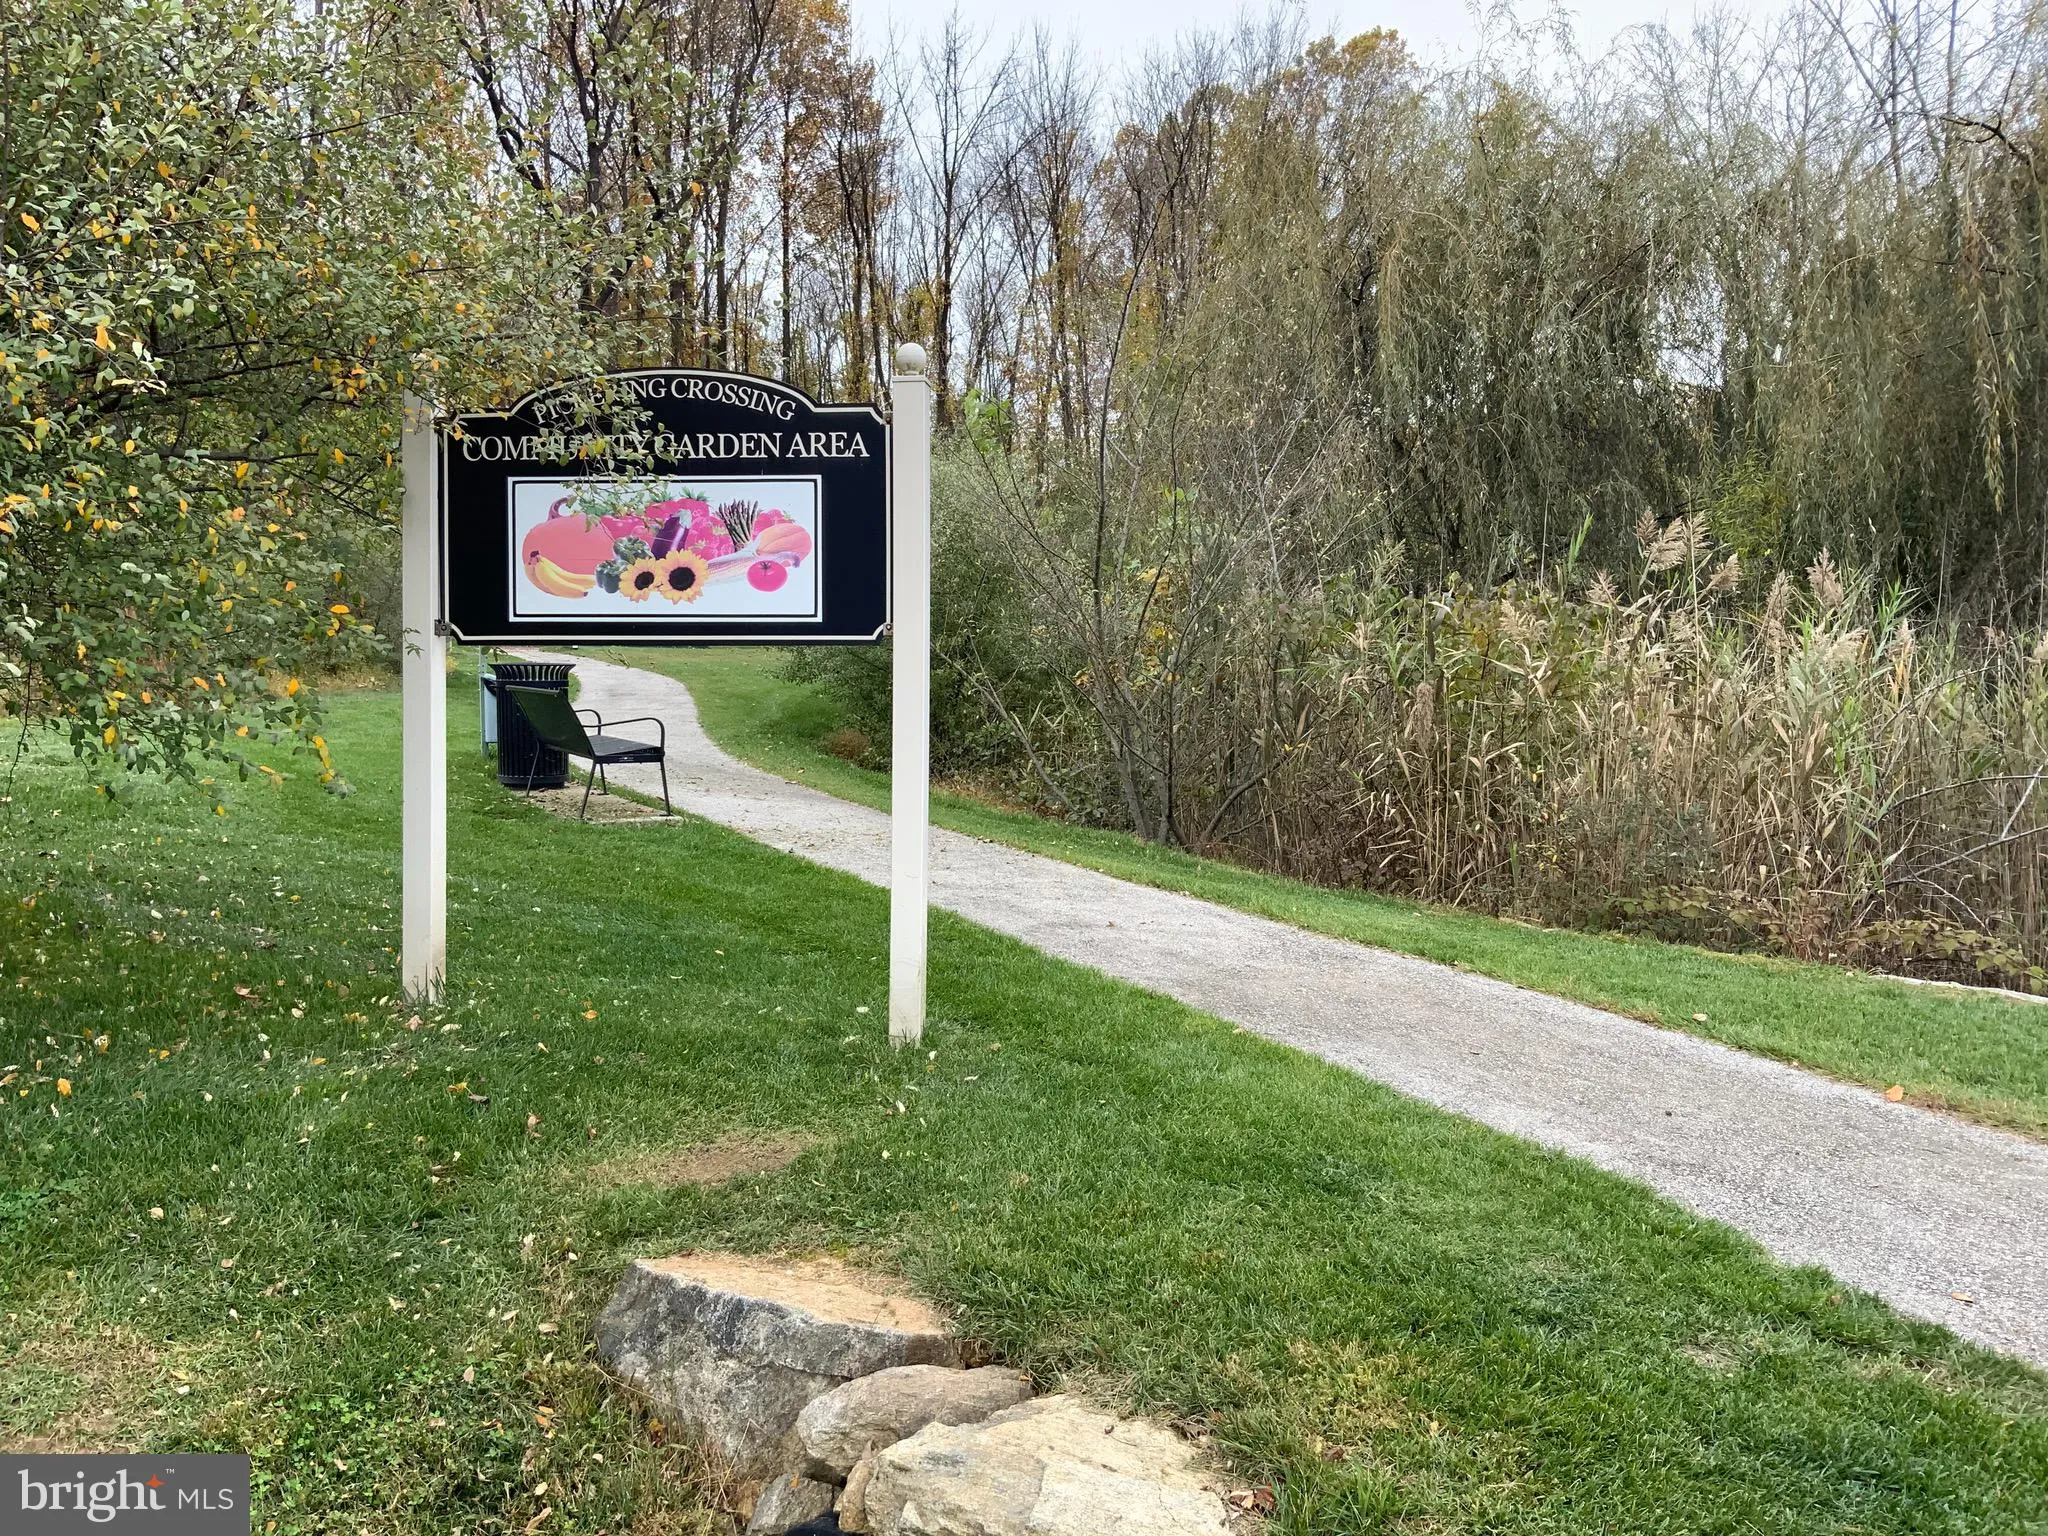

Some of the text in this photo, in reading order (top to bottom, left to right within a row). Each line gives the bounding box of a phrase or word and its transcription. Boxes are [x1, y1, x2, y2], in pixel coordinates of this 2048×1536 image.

[531, 377, 797, 424] PICENG CROSSING
[462, 431, 870, 461] COMUTY GARDEN AREA
